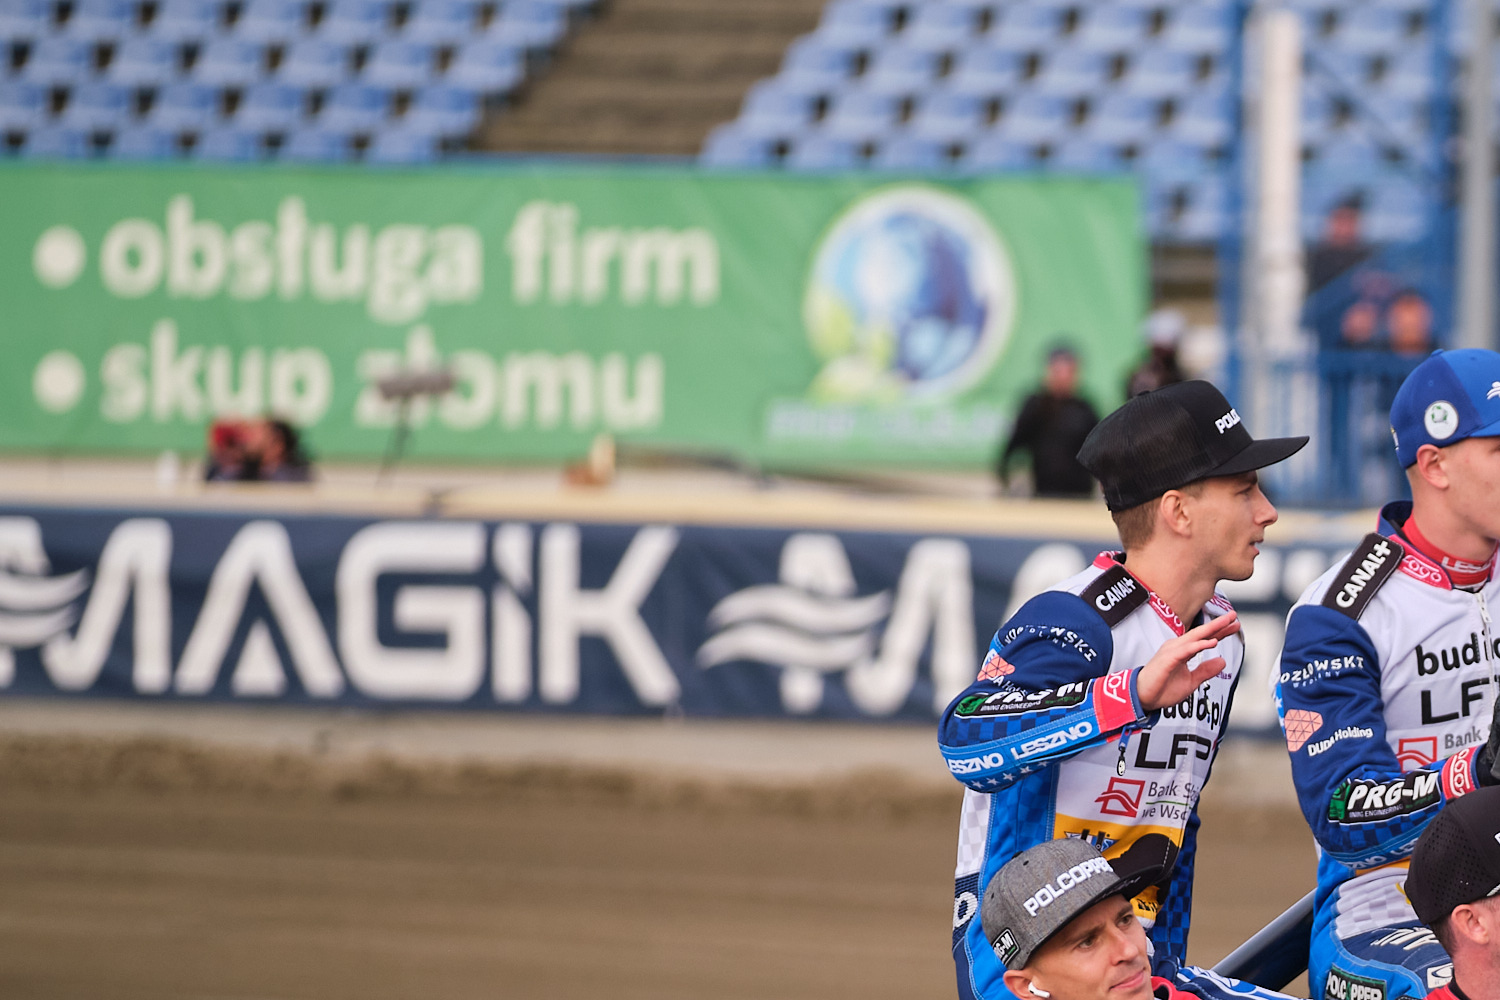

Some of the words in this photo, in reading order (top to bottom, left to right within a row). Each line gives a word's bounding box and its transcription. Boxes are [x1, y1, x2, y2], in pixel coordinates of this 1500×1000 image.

[100, 195, 484, 324] obsługa
[506, 202, 720, 306] firm
[354, 325, 666, 431] złomu
[1094, 576, 1137, 612] CANAL+
[1335, 540, 1392, 609] CANAL+
[1010, 720, 1094, 760] LESZNO
[1307, 738, 1336, 757] DUDA
[1333, 726, 1374, 743] Holding
[1445, 728, 1482, 750] Bank
[1347, 771, 1440, 810] PRG-M
